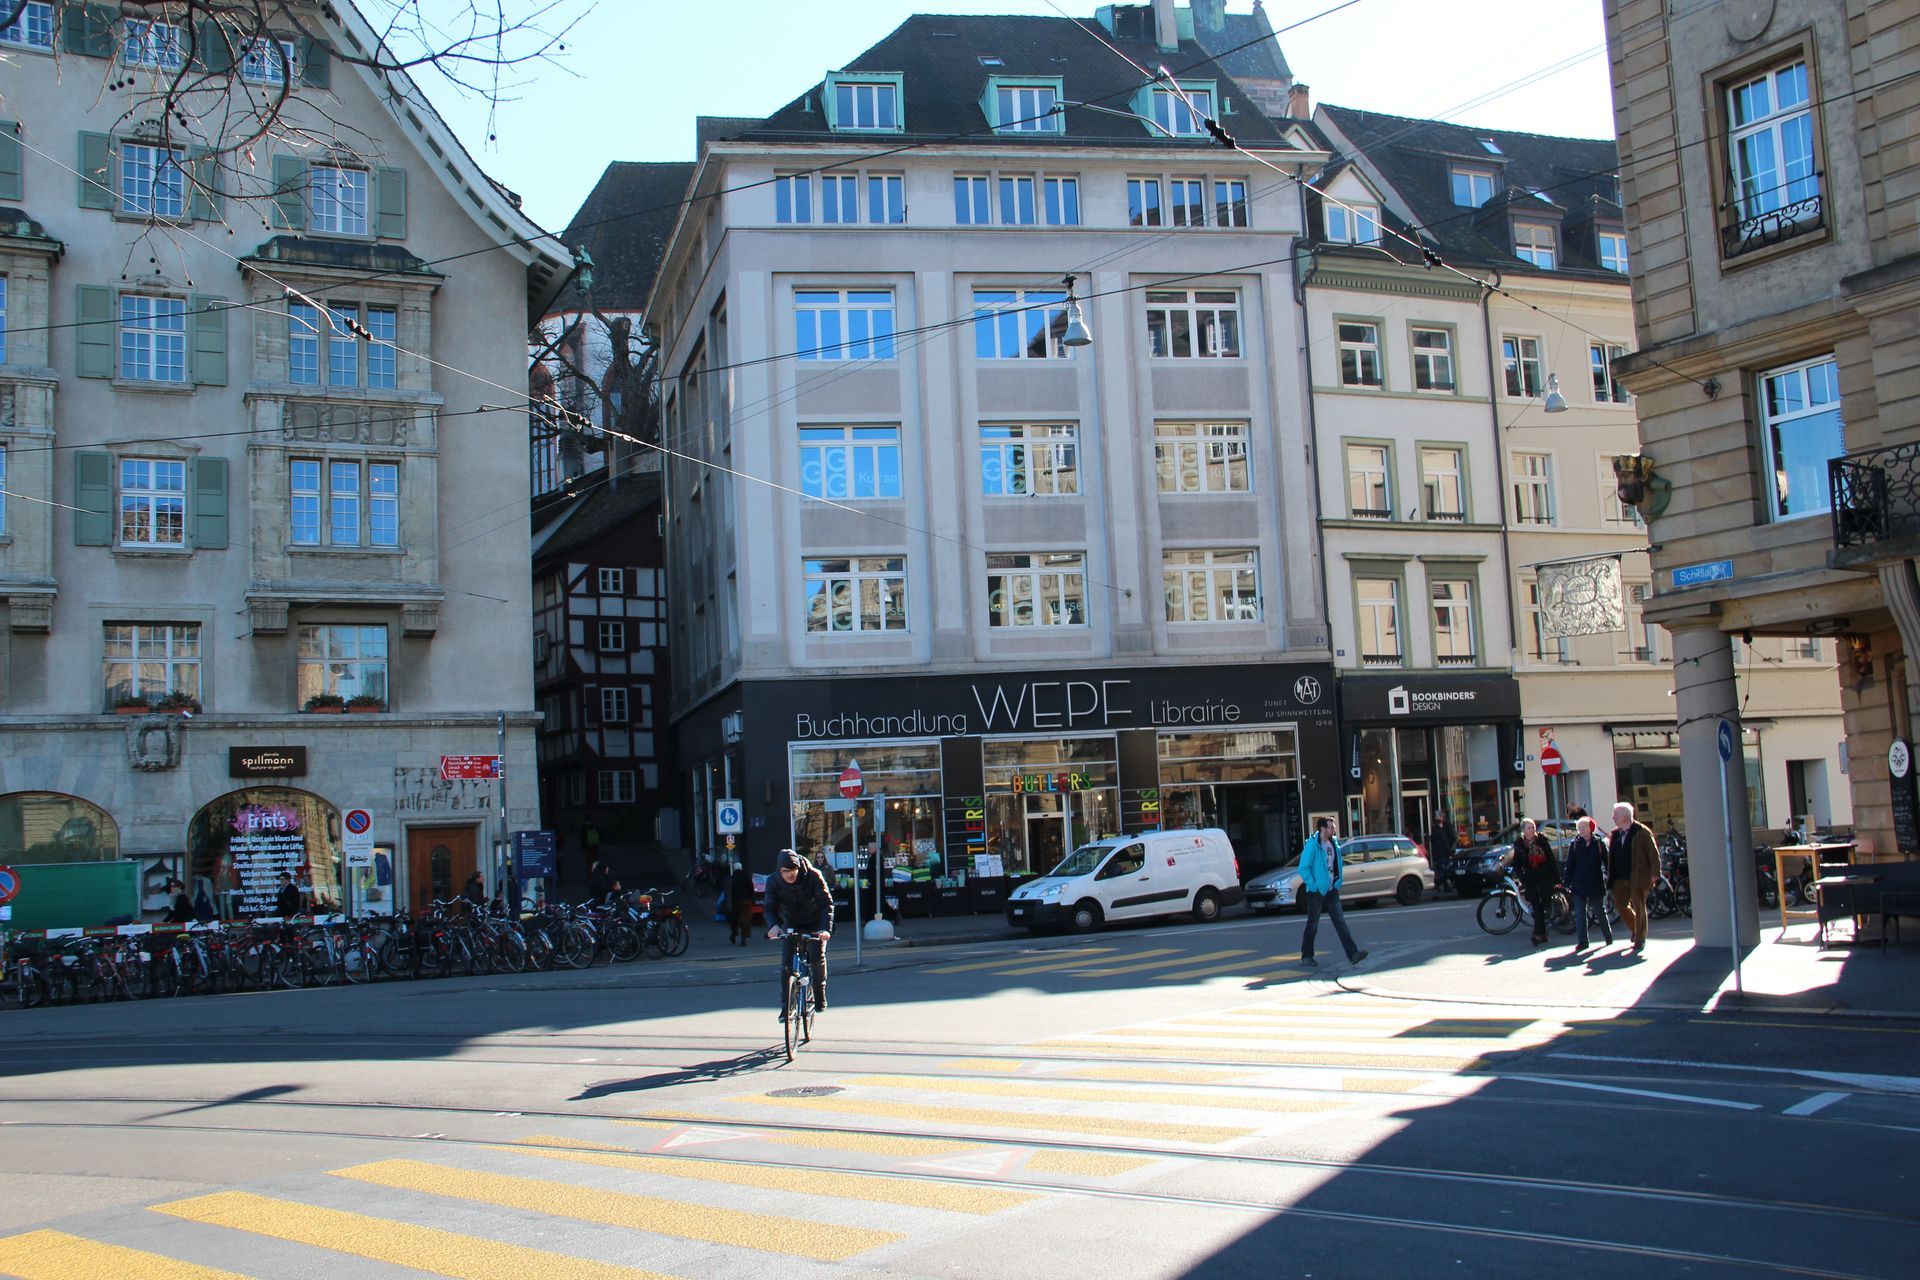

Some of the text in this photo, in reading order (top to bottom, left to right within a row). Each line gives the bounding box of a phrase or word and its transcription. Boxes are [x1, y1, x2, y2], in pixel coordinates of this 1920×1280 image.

[1412, 692, 1475, 701] BOOKBINDERS
[797, 680, 1240, 738] Buchhandlung WEPF Librairie
[1277, 709, 1332, 717] SPINNWETTERN
[1412, 702, 1440, 711] DESIGN
[242, 755, 294, 768] spillmann
[1013, 772, 1092, 793] BUTLERS
[248, 813, 260, 828] Er
